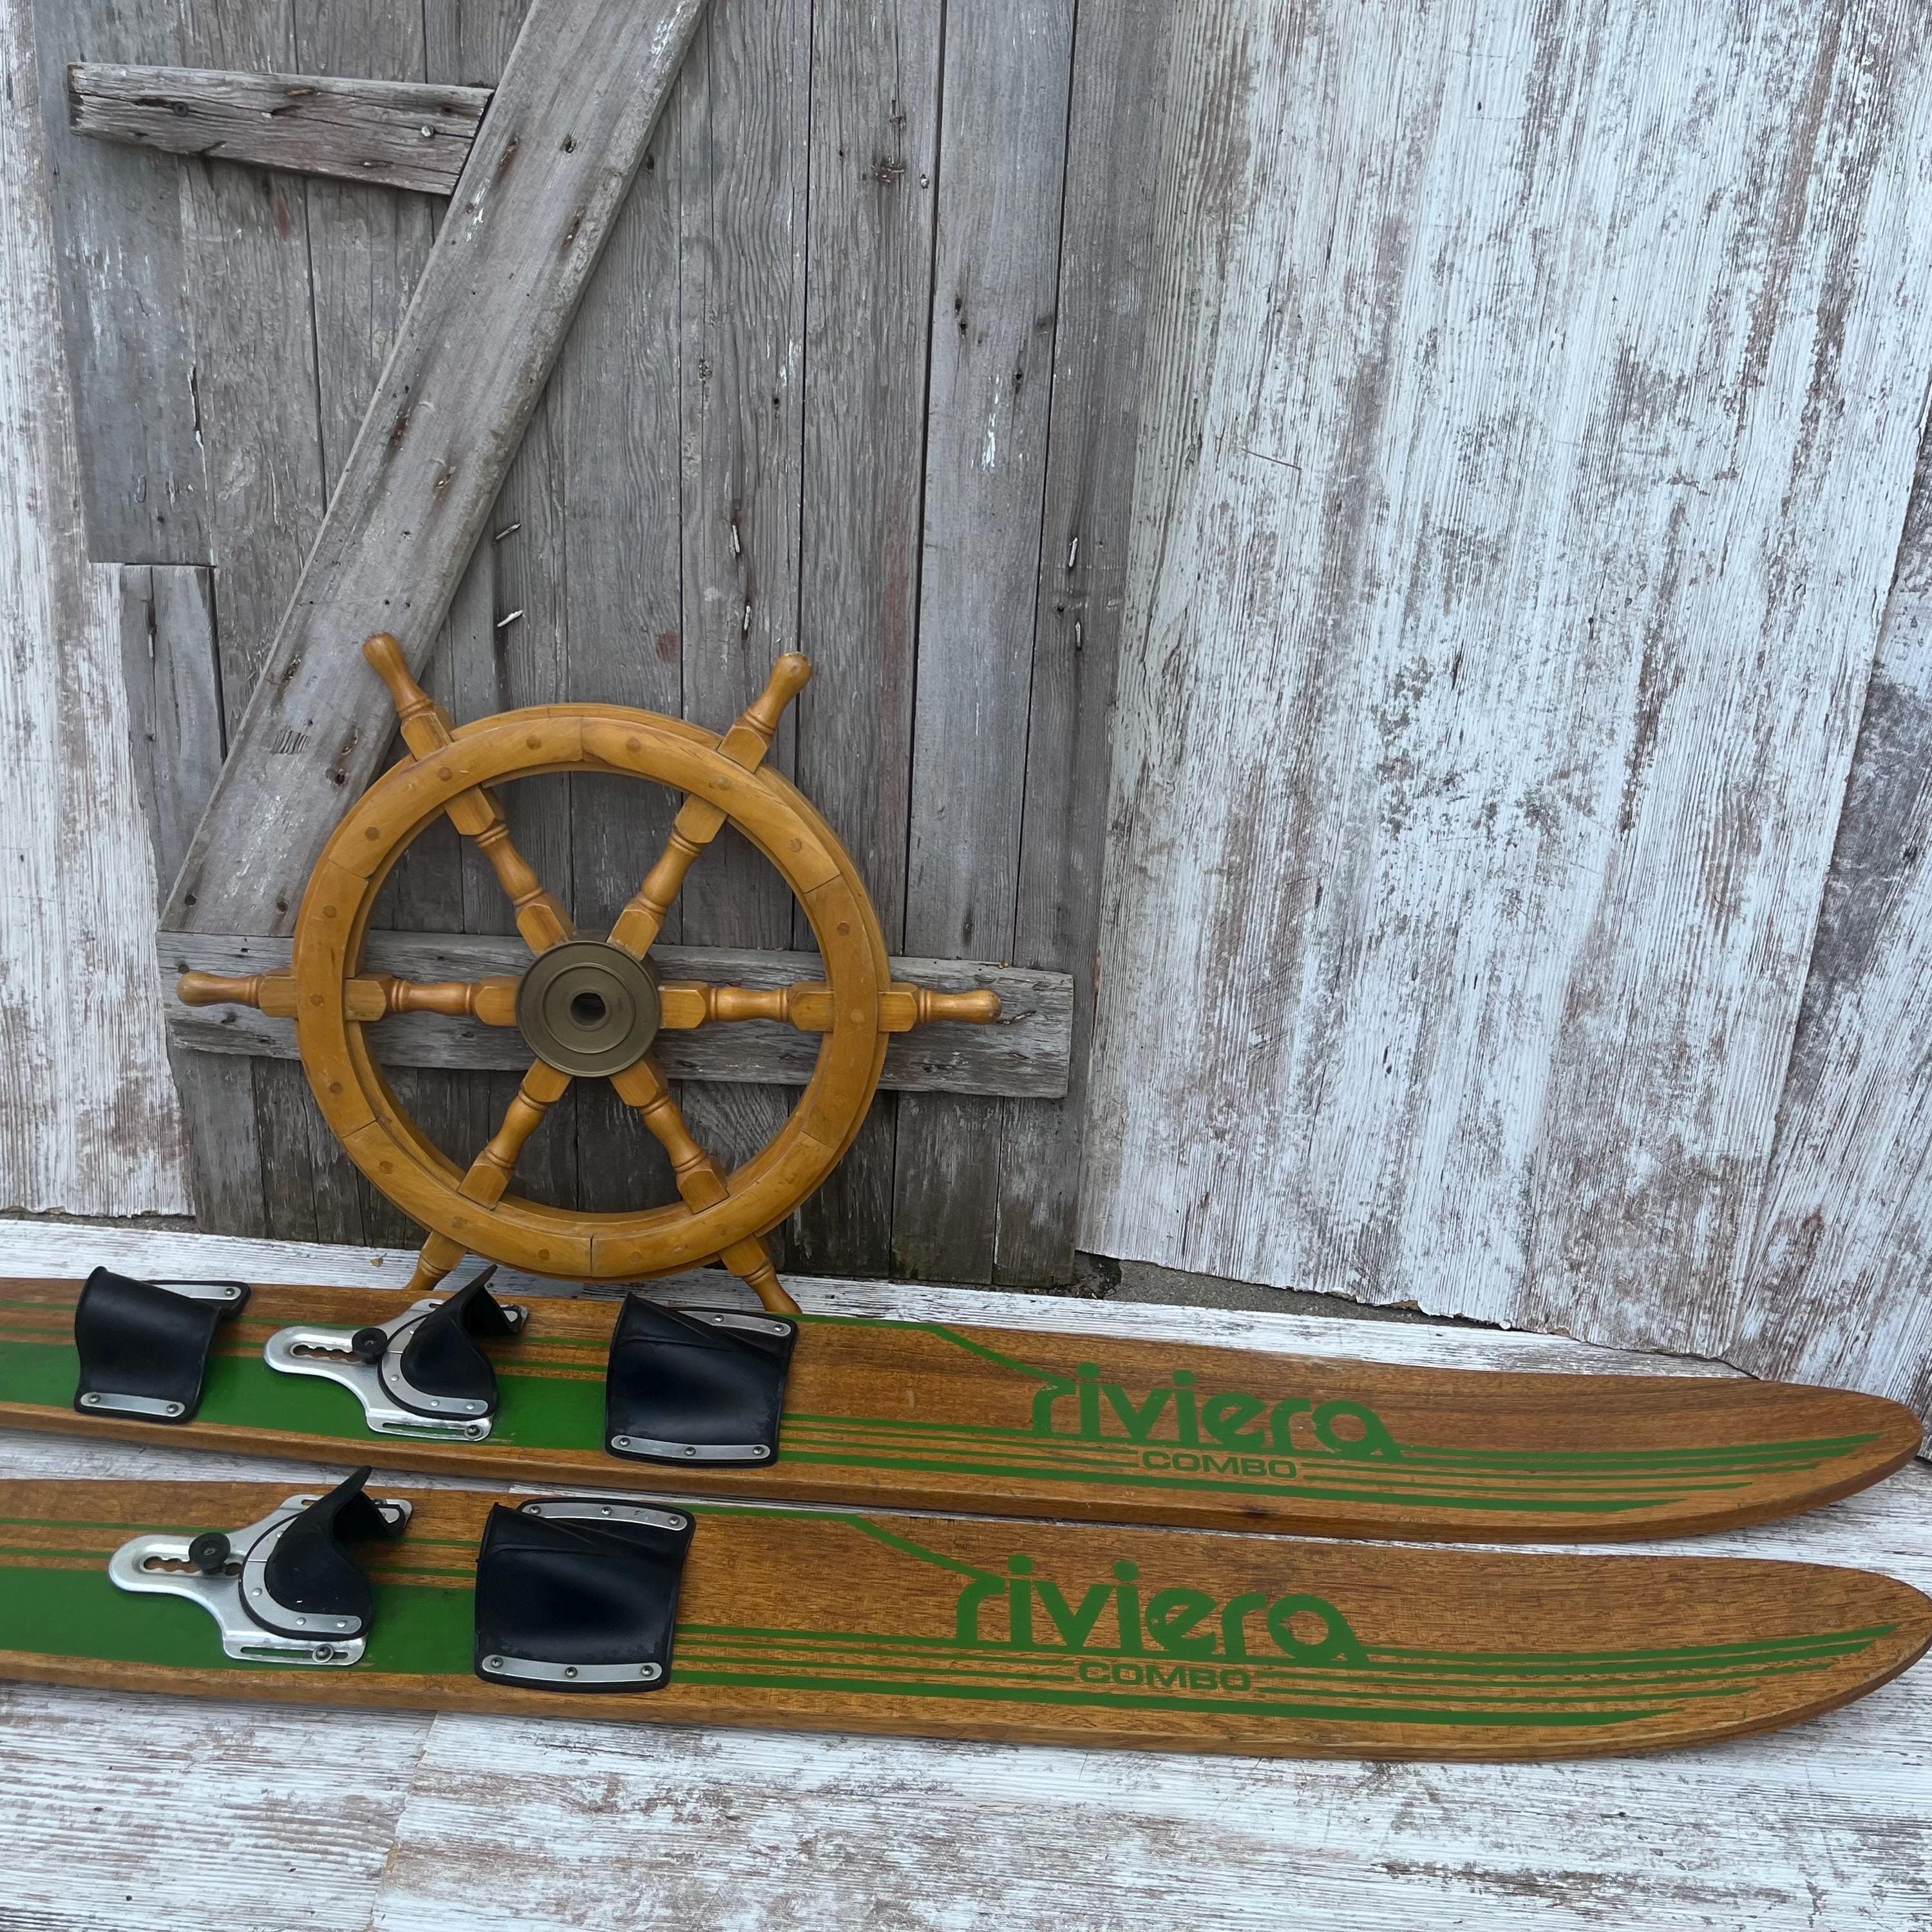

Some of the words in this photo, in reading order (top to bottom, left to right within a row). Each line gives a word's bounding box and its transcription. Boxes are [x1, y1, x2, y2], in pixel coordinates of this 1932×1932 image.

[1032, 1362, 1403, 1463] riviera
[1142, 1450, 1297, 1479] COMBO
[956, 1555, 1370, 1663] riviera
[1079, 1662, 1252, 1692] COMBO
